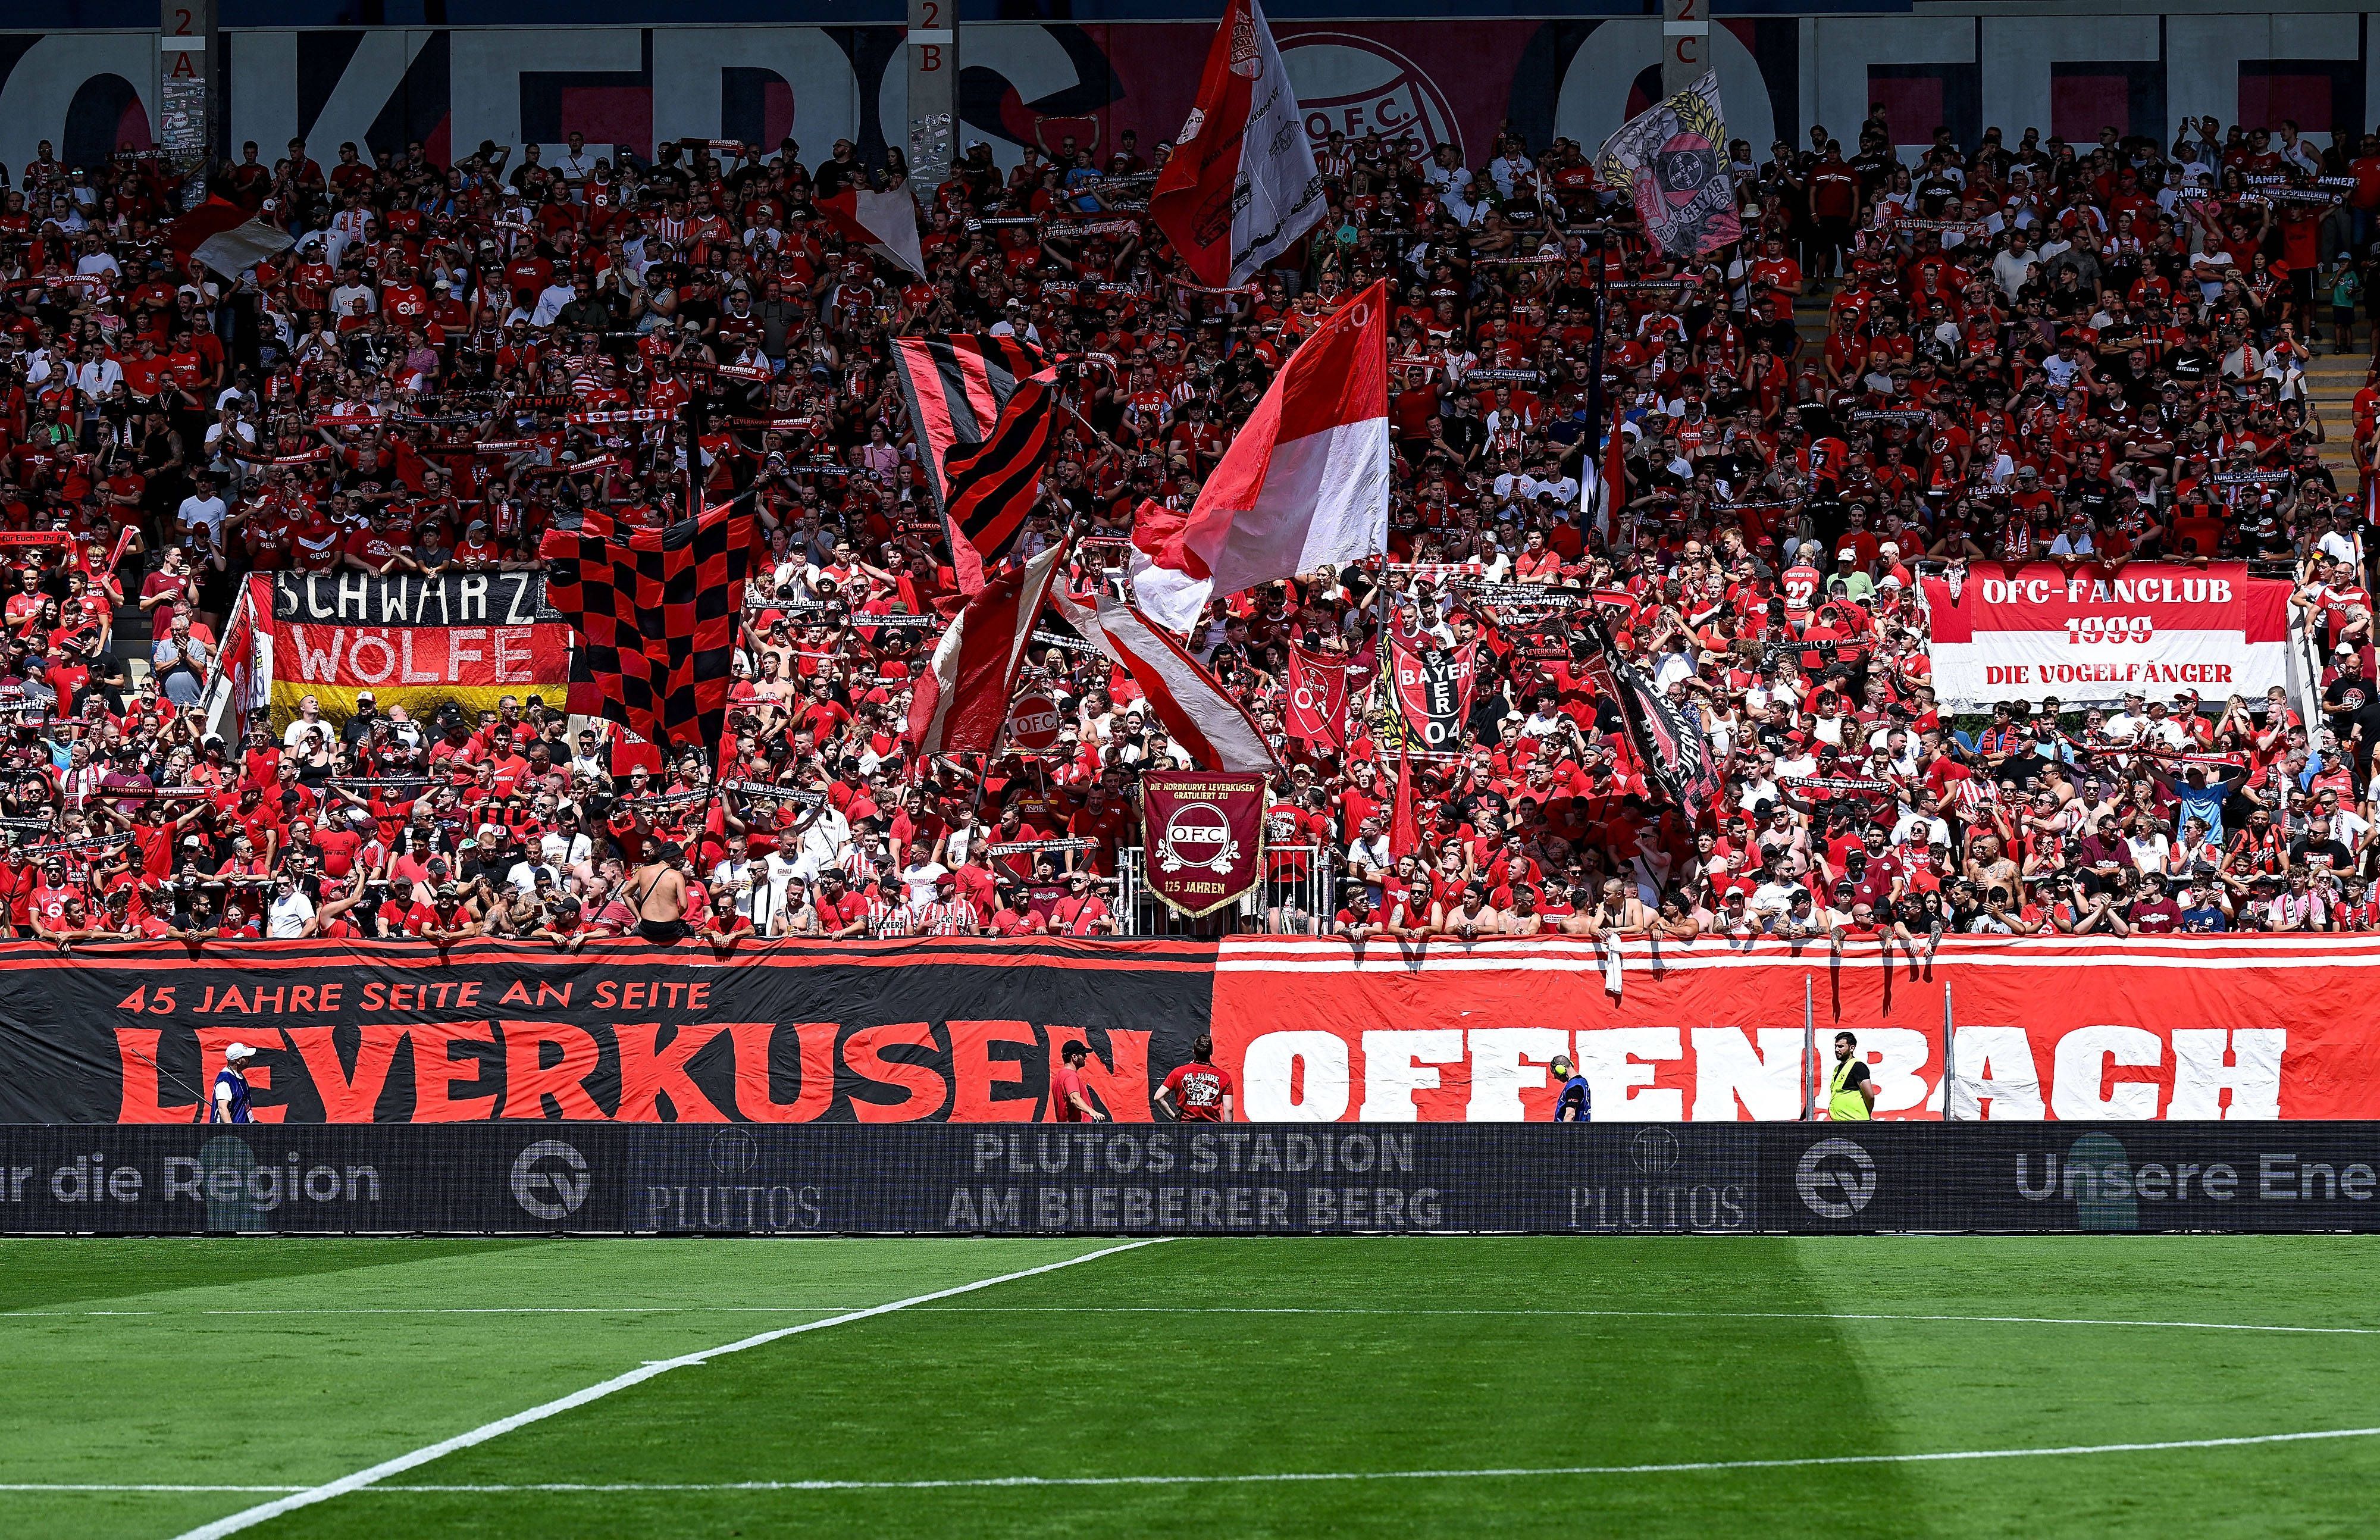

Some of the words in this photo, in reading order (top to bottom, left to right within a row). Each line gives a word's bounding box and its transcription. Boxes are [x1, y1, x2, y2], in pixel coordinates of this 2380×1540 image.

[176, 9, 192, 35] 2
[922, 2, 940, 29] 2
[920, 45, 941, 71] B
[1677, 37, 1696, 63] C
[171, 52, 196, 78] A
[494, 220, 527, 232] OFFENBACH
[1044, 227, 1083, 238] LEVERKUSEN
[1894, 219, 1933, 230] FREUND
[64, 274, 102, 285] OFFENBACH
[719, 365, 757, 375] OFFENBACH
[275, 452, 311, 461] OFFENBACH
[570, 456, 606, 468] OFFENBACH
[2213, 471, 2289, 481] TURN-U-SPIELVEREIN
[315, 550, 330, 559] EVO
[366, 539, 392, 550] KICKERS
[1785, 580, 1814, 604] 22
[1983, 577, 2233, 605] OFC-FANCLUB
[2335, 602, 2346, 611] EVO
[852, 615, 928, 623] TURN-U-SPIELVEREIN
[2063, 615, 2154, 644] 1999
[292, 625, 533, 684] WÖLFE
[1401, 661, 1471, 687] BAYER
[1987, 665, 2029, 684] DIE
[2038, 660, 2233, 684] VOGELFÄNGER
[1016, 713, 1057, 734] O.F.C.
[1424, 716, 1461, 744] 04
[743, 781, 823, 803] TURN-U-SPIELVEREIN
[1150, 782, 1161, 791] DIE
[1163, 783, 1207, 791] NORDKURVE
[1208, 783, 1255, 792] LEVERKUSEN
[1273, 811, 1296, 820] JAHRE
[1172, 828, 1225, 842] O.F.C.
[1164, 881, 1180, 893] 125
[1183, 881, 1226, 894] JAHREN
[117, 984, 176, 1015] 45
[193, 983, 343, 1014] JAHRE
[359, 981, 481, 1012] SEITE
[498, 979, 573, 1008] AN
[591, 979, 712, 1010] SEITE
[114, 1020, 1153, 1123] LEVERKUSEN
[1242, 1025, 2287, 1122] OFFENBACH
[1197, 1072, 1220, 1082] JAHRE
[974, 1133, 1175, 1173] PLUTOS
[1188, 1132, 1413, 1173] STADION
[52, 1151, 143, 1203] die
[164, 1151, 380, 1212] Region
[2016, 1154, 2238, 1201] Unsere
[2260, 1154, 2377, 1201] Ene
[647, 1186, 822, 1228] PLUTOS
[944, 1188, 1021, 1228] AM
[1039, 1187, 1292, 1228] BIEBERER
[1307, 1187, 1442, 1228] BERG
[1568, 1186, 1744, 1228] PLUTOS
